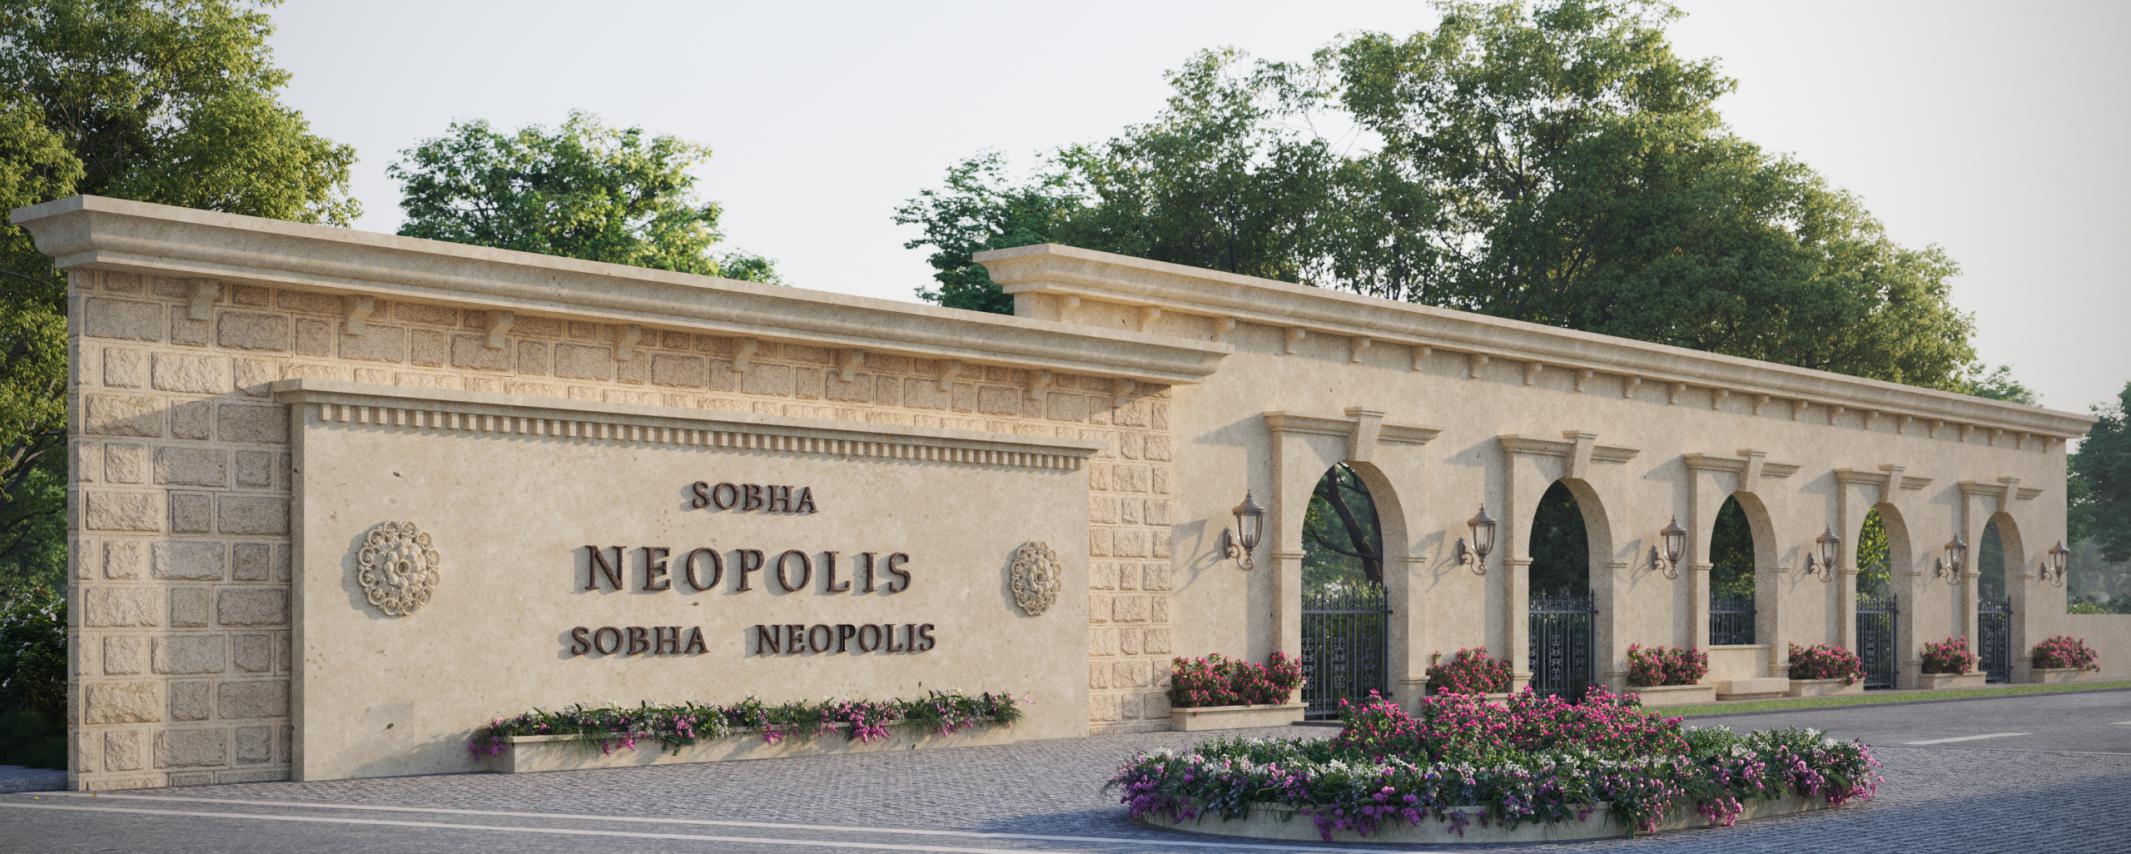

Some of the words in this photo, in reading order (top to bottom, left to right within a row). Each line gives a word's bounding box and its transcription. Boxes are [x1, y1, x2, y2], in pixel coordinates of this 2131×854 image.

[691, 480, 818, 514] SOBHA
[585, 544, 912, 593] NEOPOLIS
[570, 625, 710, 656] SOBHA
[755, 623, 937, 655] NEOPOLIS
